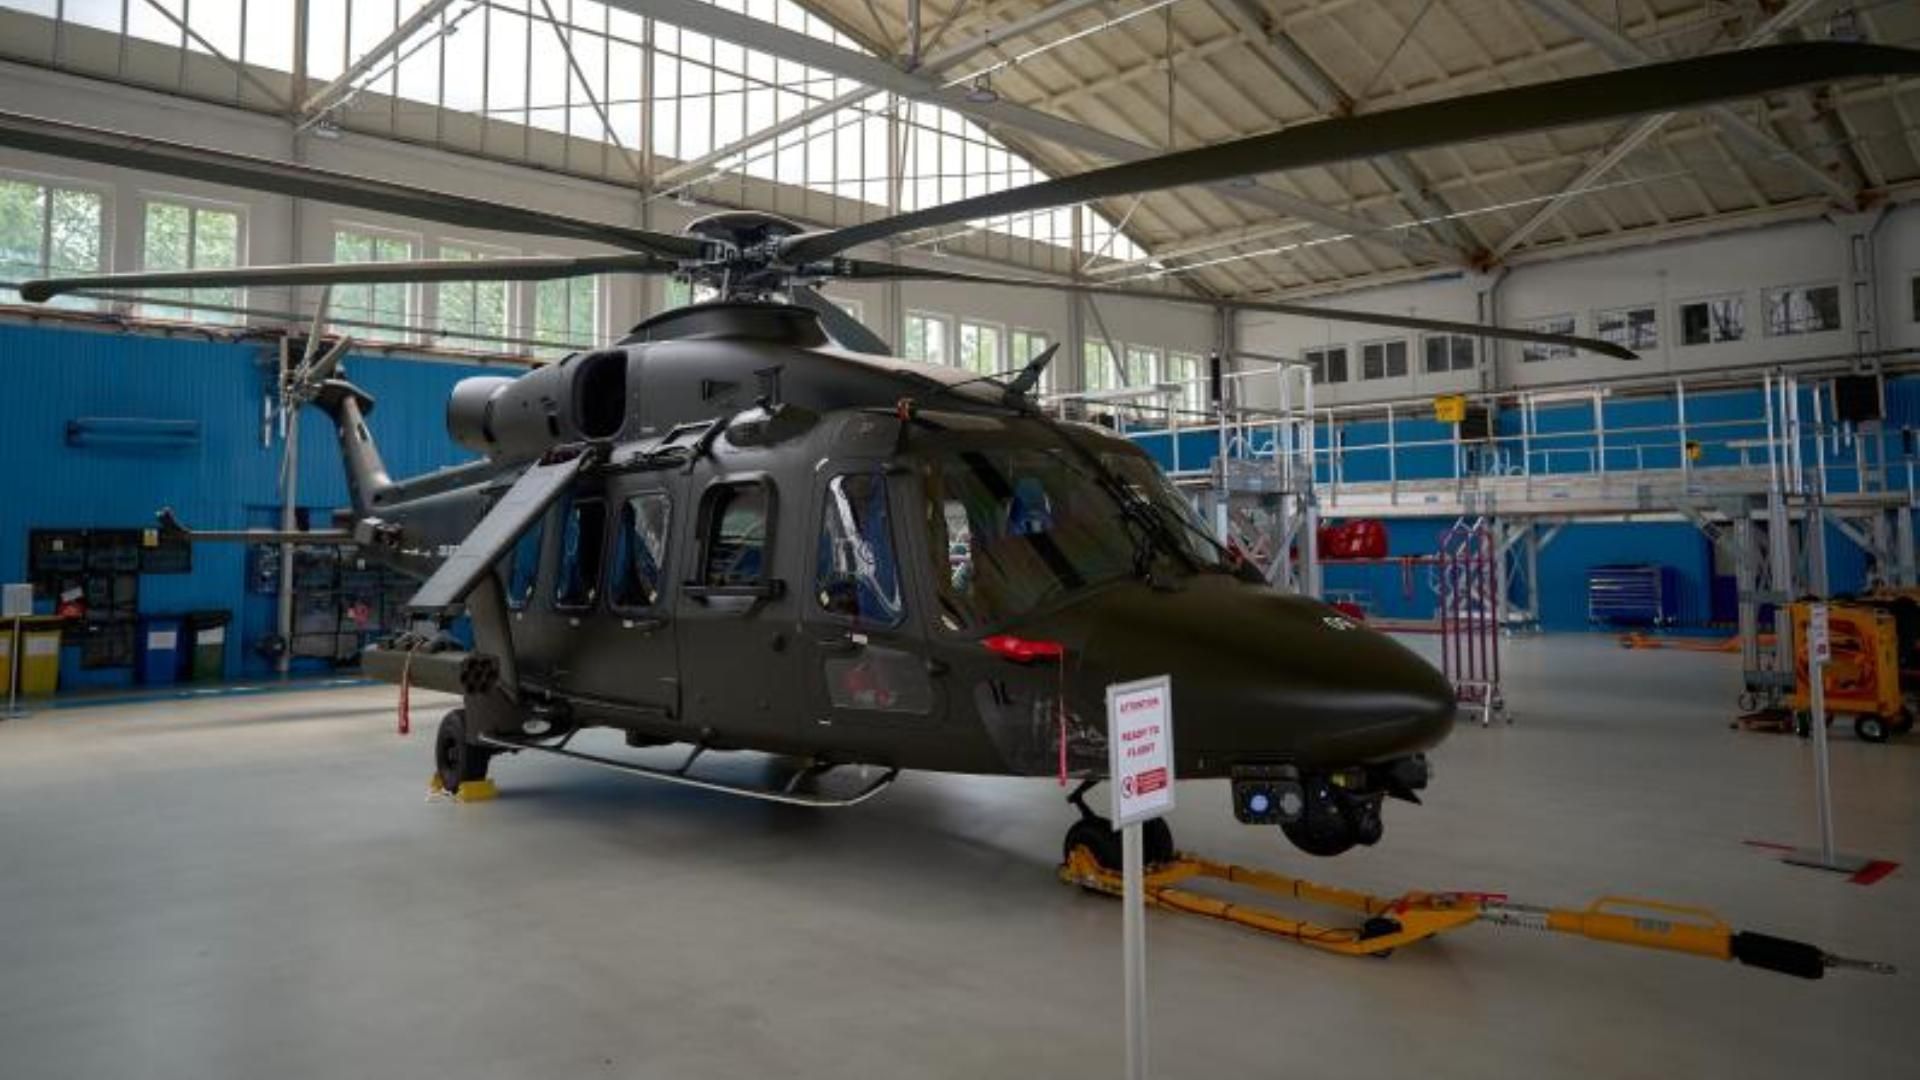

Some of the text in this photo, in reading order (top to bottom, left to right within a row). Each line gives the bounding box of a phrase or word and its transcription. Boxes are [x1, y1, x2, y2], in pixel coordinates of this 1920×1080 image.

[1120, 697, 1160, 713] ATTENTION
[1121, 725, 1160, 741] READY TO
